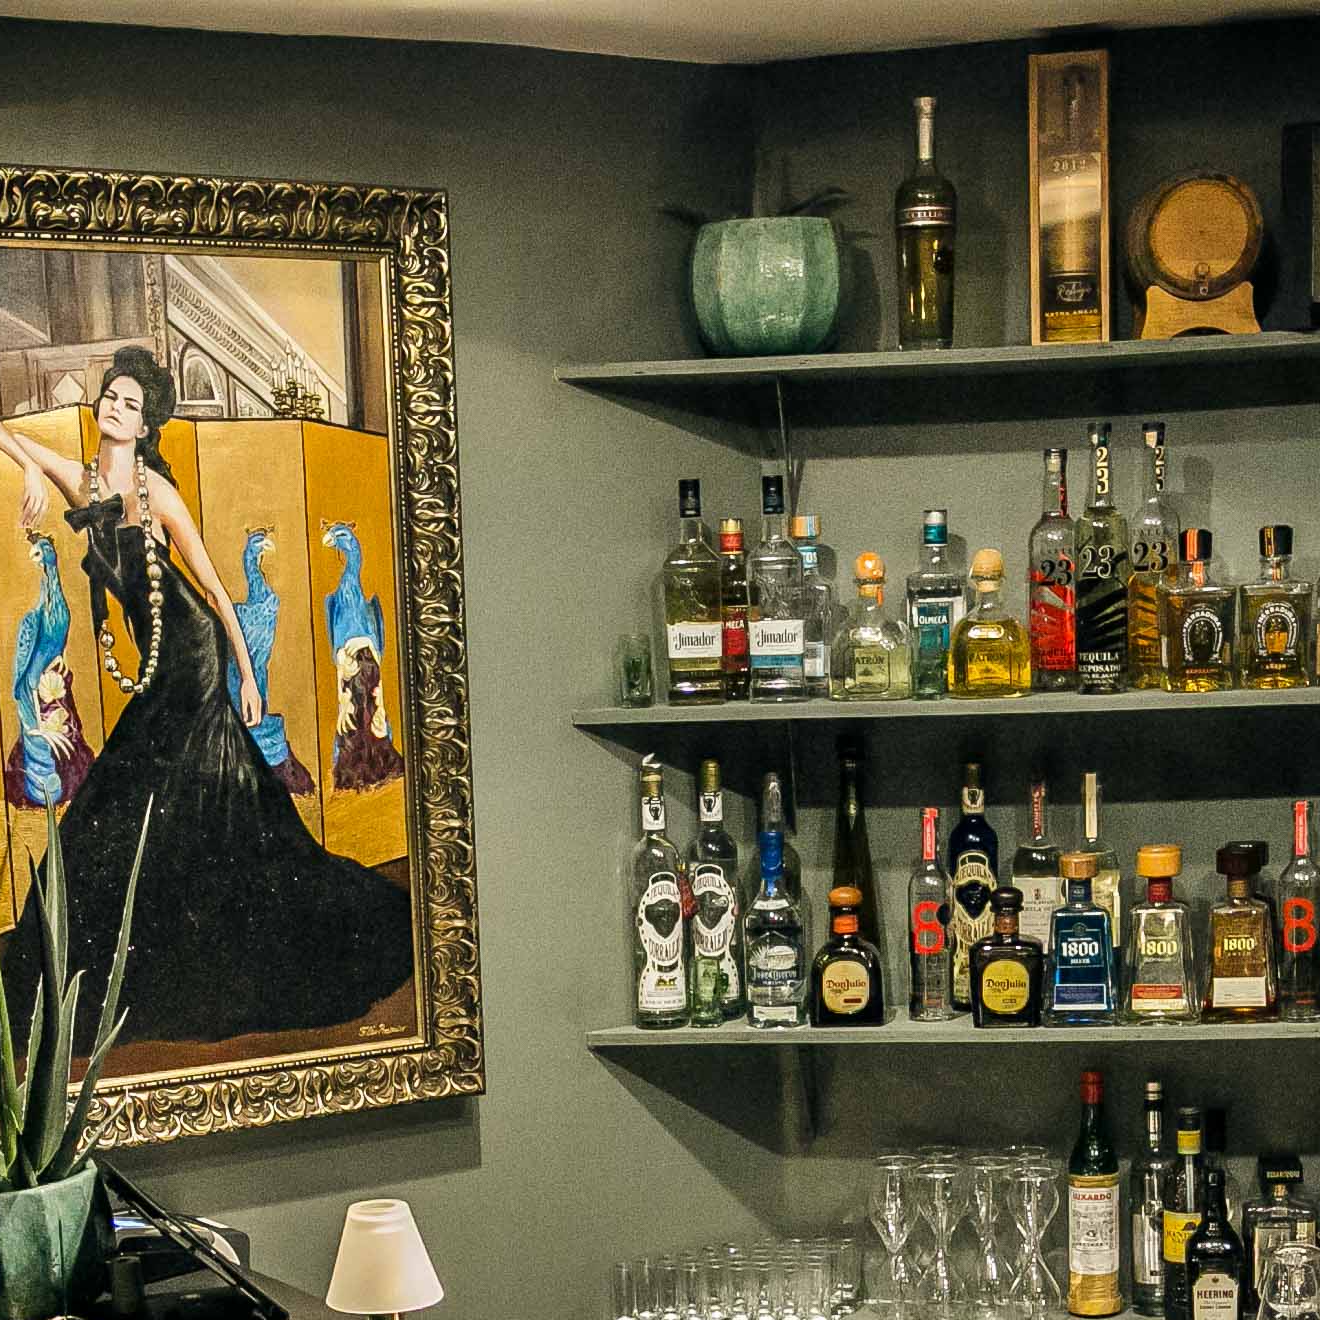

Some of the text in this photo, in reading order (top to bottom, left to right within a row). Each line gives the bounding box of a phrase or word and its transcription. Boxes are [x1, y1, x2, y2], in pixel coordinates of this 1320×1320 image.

[1082, 545, 1114, 579] 23
[1134, 542, 1168, 572] 23
[1040, 560, 1072, 586] 23
[919, 615, 948, 625] OLMECA
[1182, 610, 1223, 634] HERRADURA
[1256, 605, 1298, 628] HERRADURA
[675, 632, 716, 650] Jimador
[757, 629, 798, 647] Jimador
[1078, 651, 1120, 664] TEQUILA
[648, 936, 681, 959] CORRALEJ
[1061, 941, 1099, 957] 1800
[1141, 940, 1178, 956] 1800
[1223, 937, 1255, 951] 1800
[1196, 1289, 1234, 1299] HEERING
